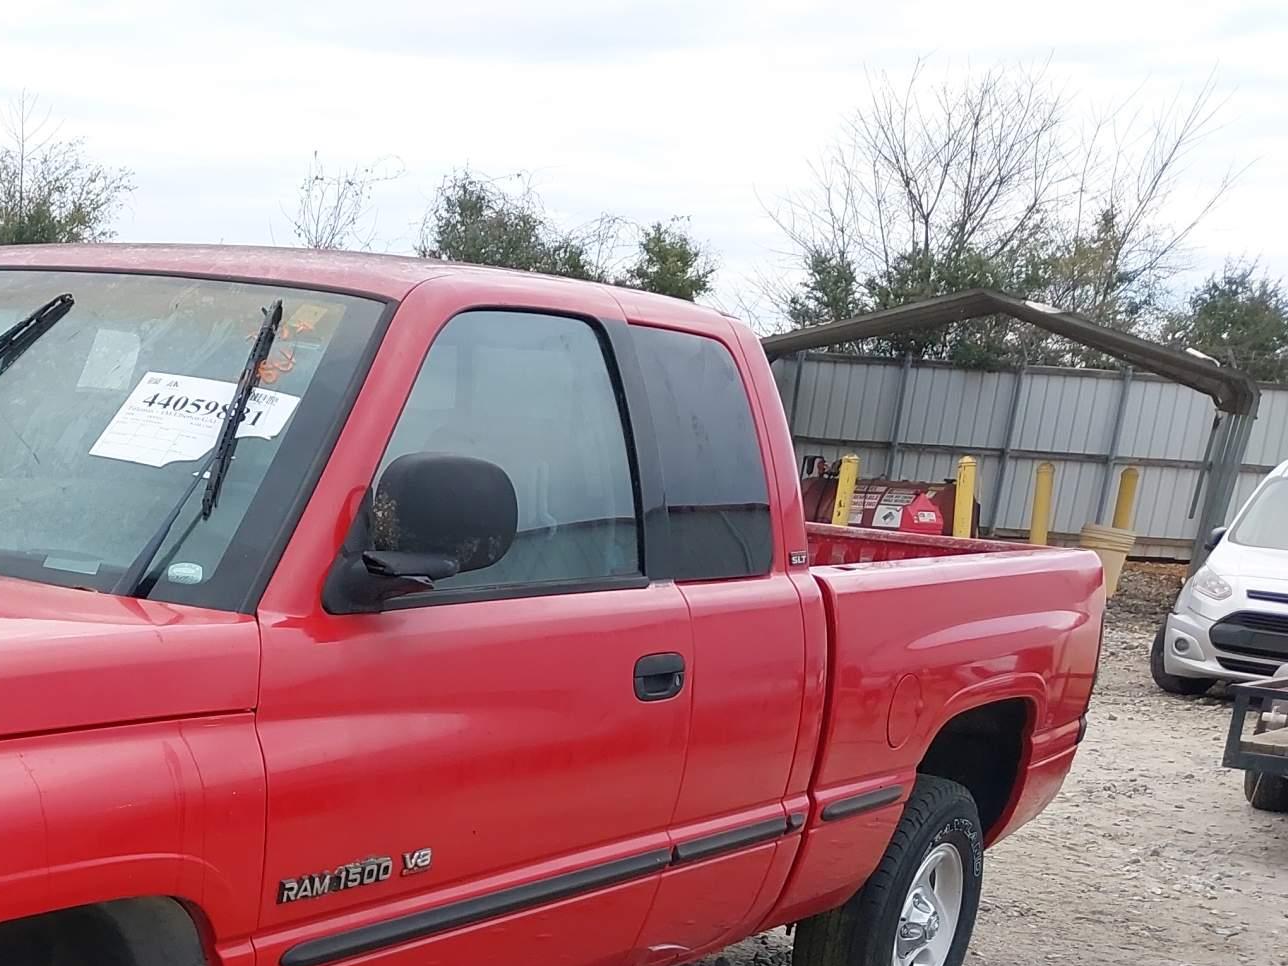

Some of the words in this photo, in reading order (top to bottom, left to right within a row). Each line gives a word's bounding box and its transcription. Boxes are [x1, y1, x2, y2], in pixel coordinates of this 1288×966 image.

[791, 555, 807, 565] SLT
[277, 878, 331, 904] RAM
[334, 856, 393, 892] 1500
[402, 847, 432, 873] V8
